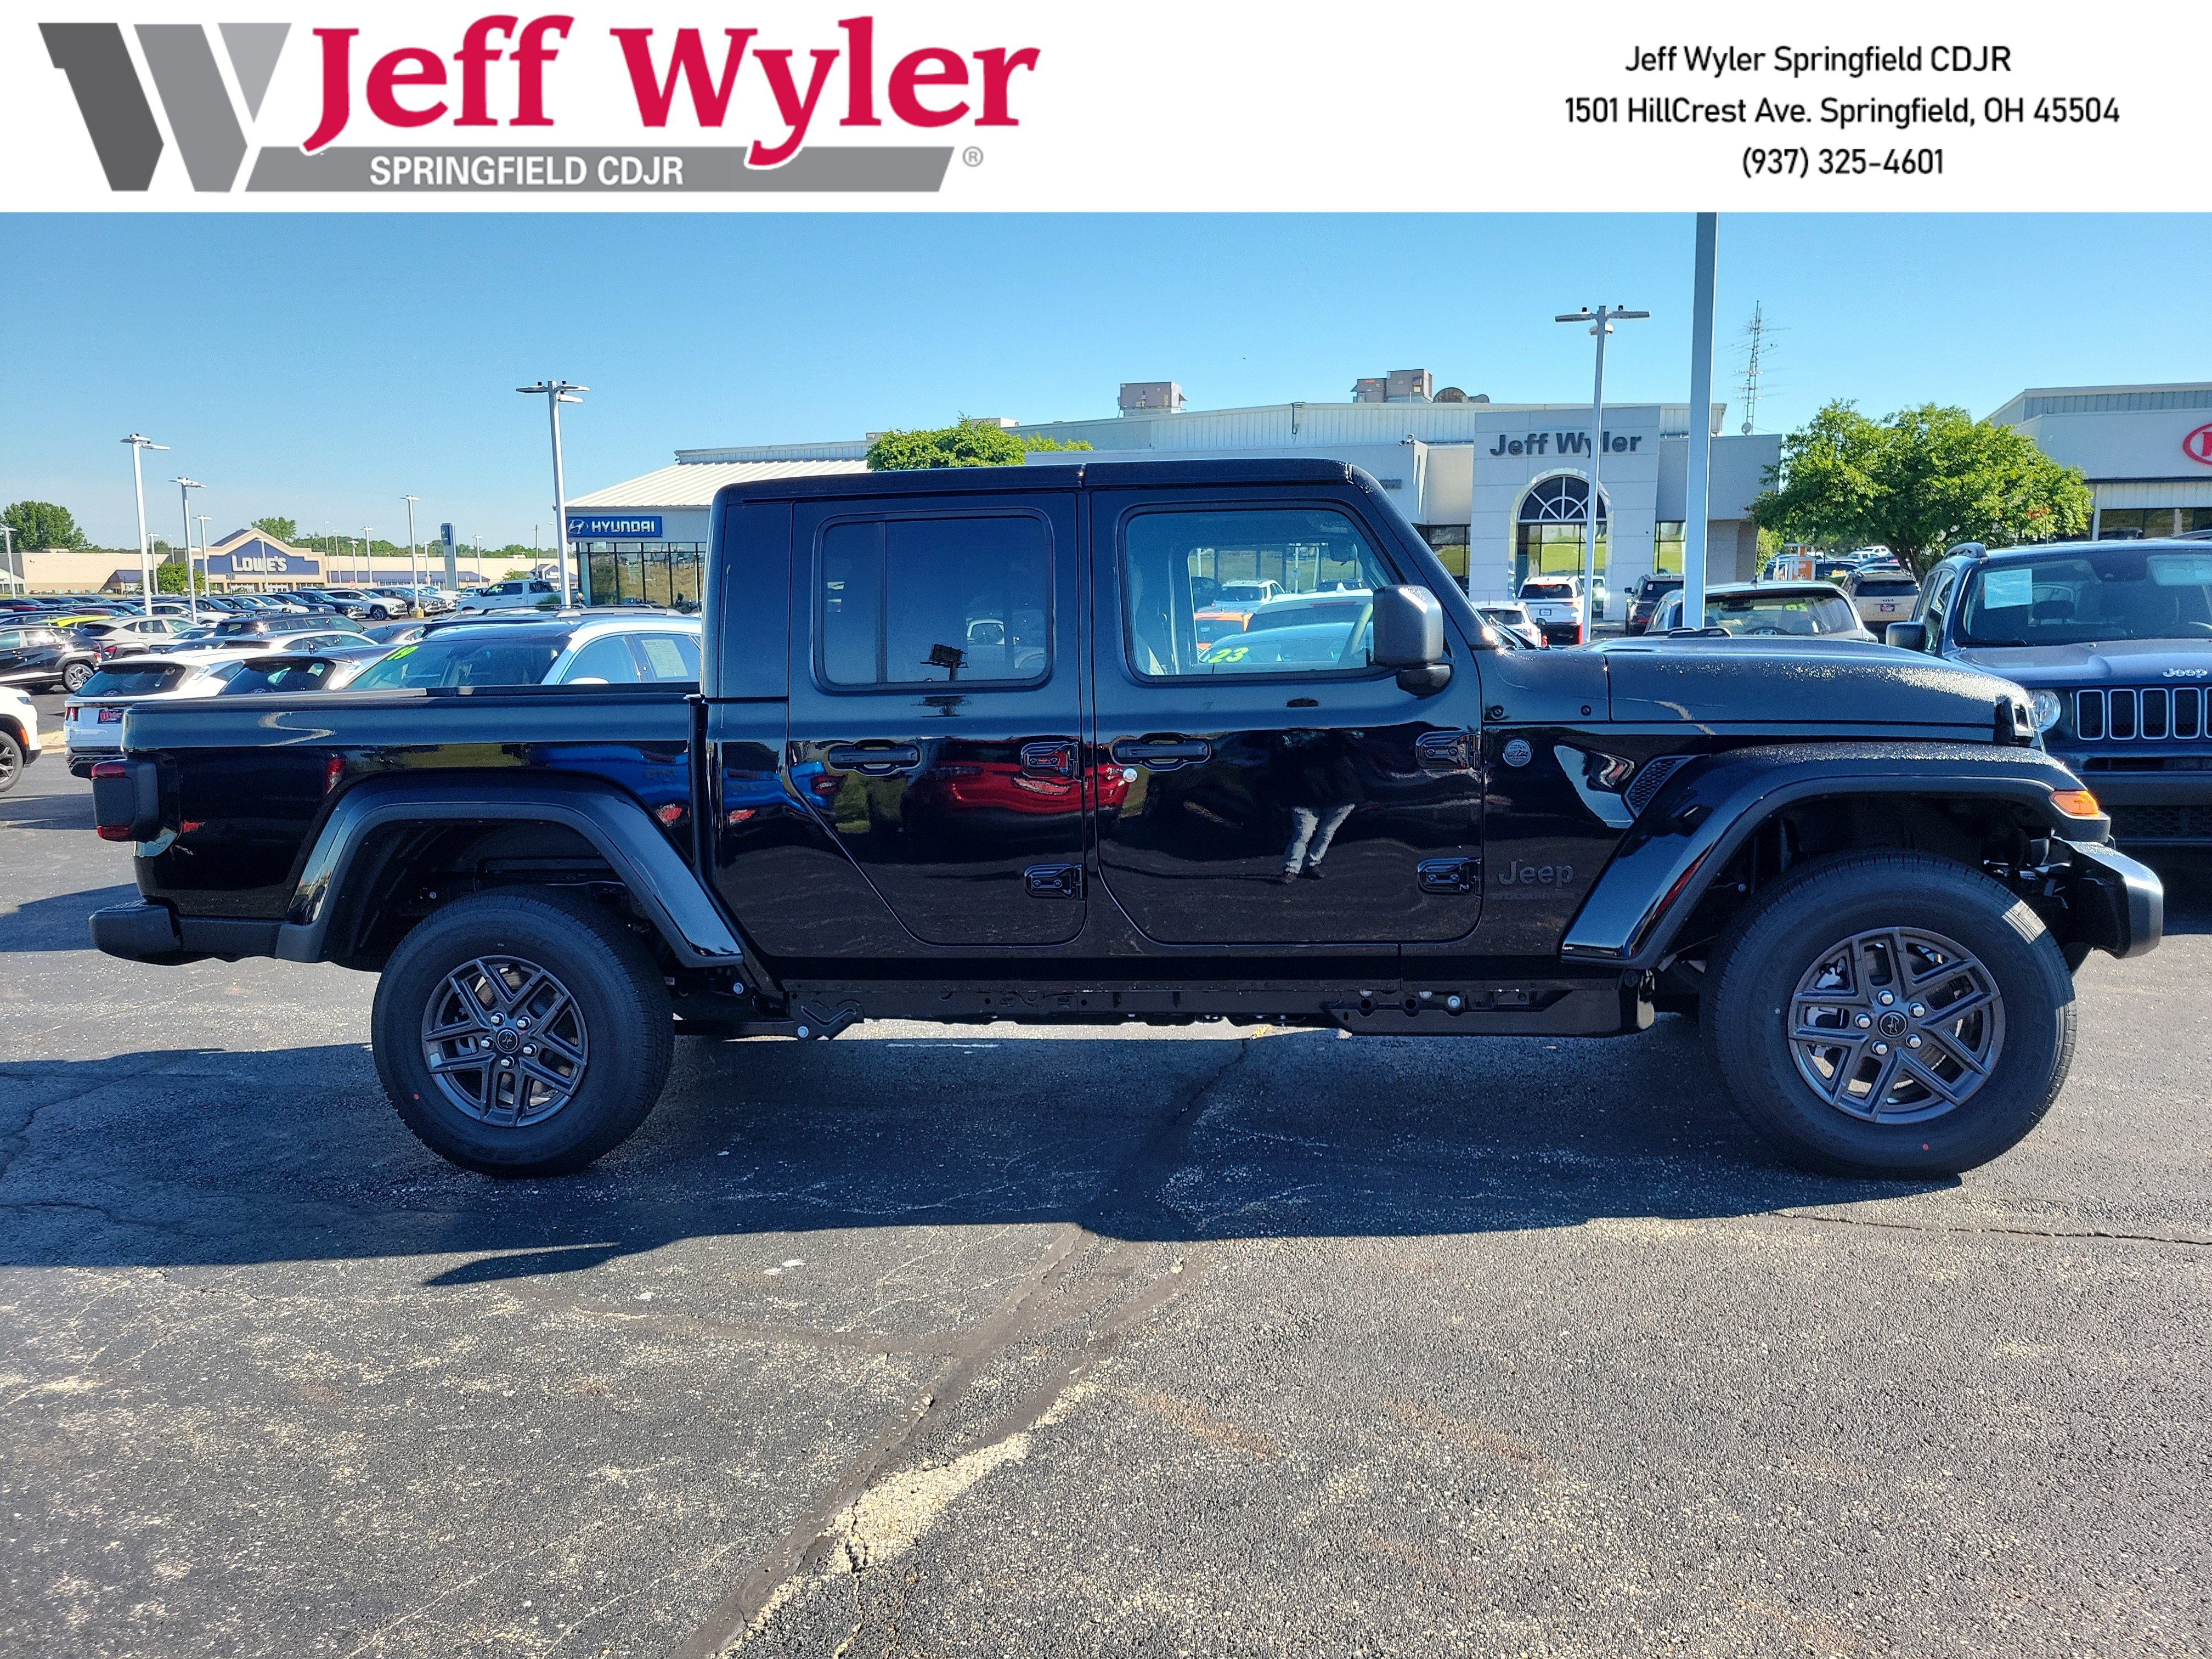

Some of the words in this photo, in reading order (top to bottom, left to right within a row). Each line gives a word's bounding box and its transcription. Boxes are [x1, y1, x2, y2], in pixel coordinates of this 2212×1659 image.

[1489, 433, 1548, 456] Jeff
[591, 521, 655, 533] HYUNDAI
[232, 555, 287, 572] LOWE'S
[1208, 647, 1249, 663] 23
[2162, 668, 2208, 678] Jeep
[1499, 861, 1574, 889] Jeep
